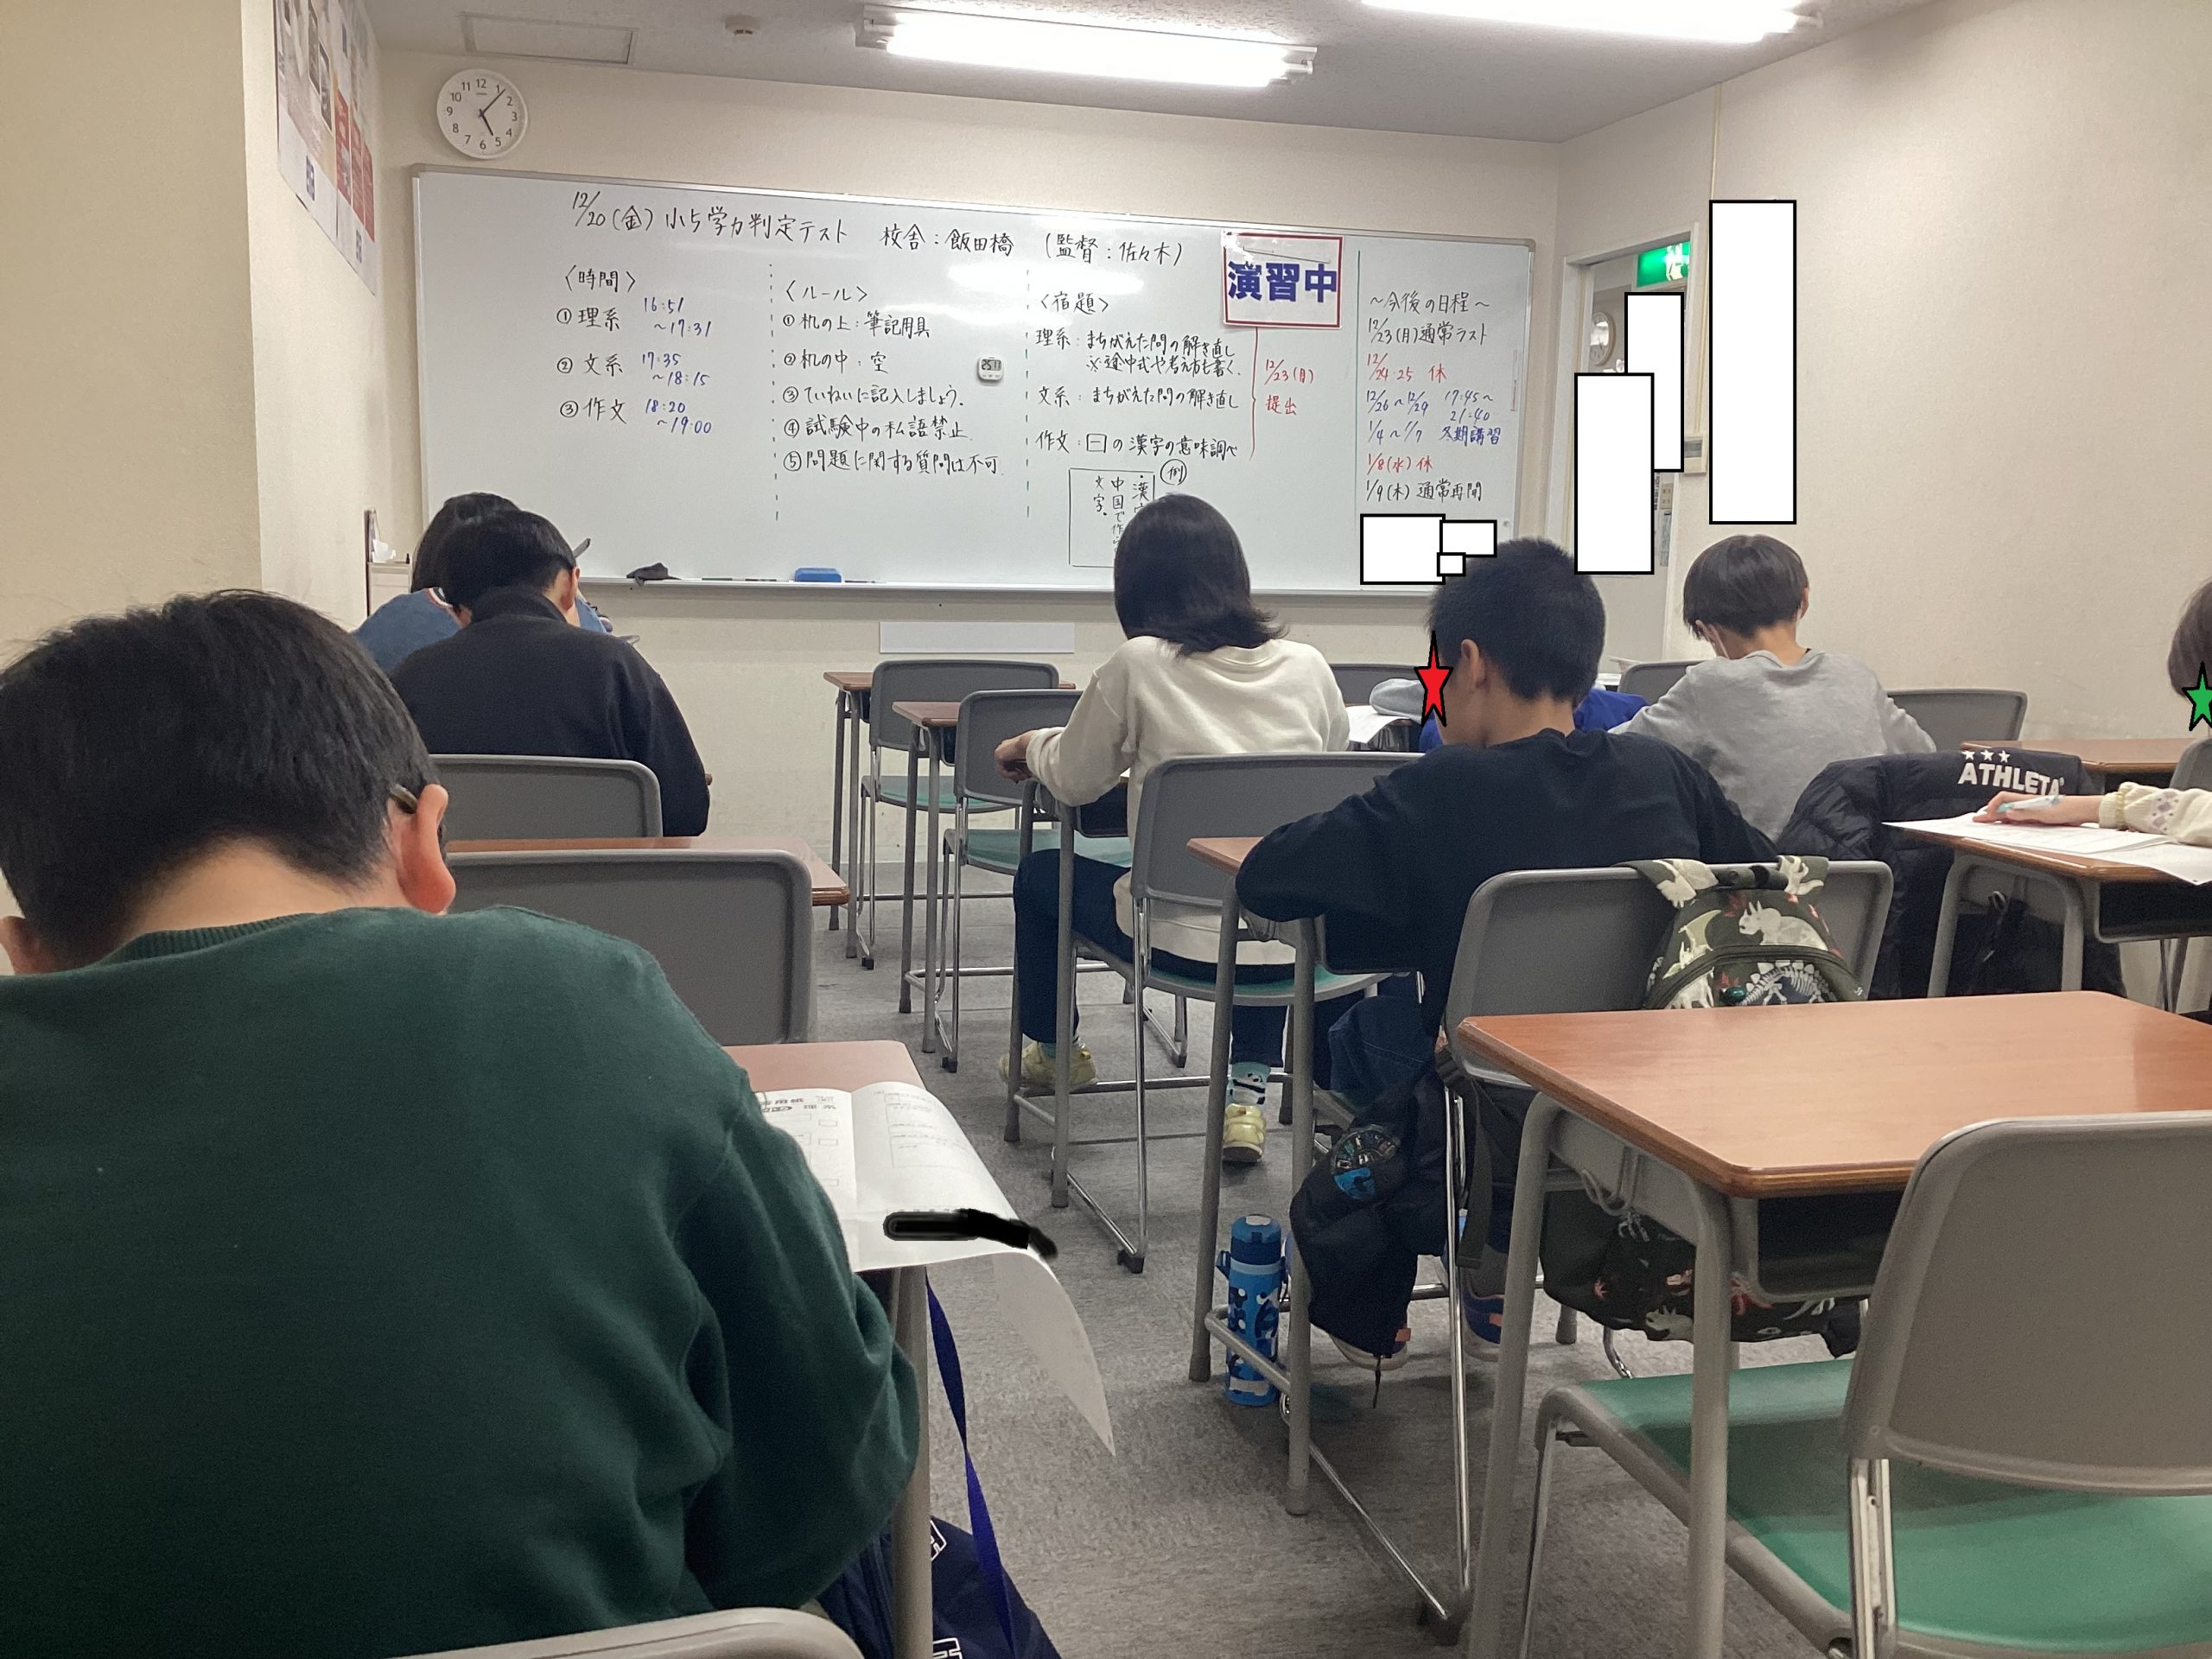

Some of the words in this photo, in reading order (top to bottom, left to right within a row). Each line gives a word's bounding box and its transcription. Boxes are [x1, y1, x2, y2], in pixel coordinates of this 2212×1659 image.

[462, 82, 470, 91] 11
[477, 79, 486, 88] 12
[451, 92, 461, 102] 10
[507, 97, 512, 105] 2
[447, 106, 453, 116] 9
[512, 111, 518, 121] 3
[453, 124, 459, 133] 8
[505, 128, 512, 137] 4
[465, 135, 471, 143] 7
[495, 137, 501, 146] 5
[480, 140, 486, 149] 6
[1228, 261, 1337, 302] 演習中
[644, 297, 683, 314] 16:51
[643, 352, 681, 370] 17:35
[1428, 363, 1446, 383] 休
[645, 398, 685, 414] 18:20
[1265, 395, 1298, 416] 提出
[1440, 425, 1501, 447] 冬期講習
[1958, 763, 2060, 796] ATHLETA
